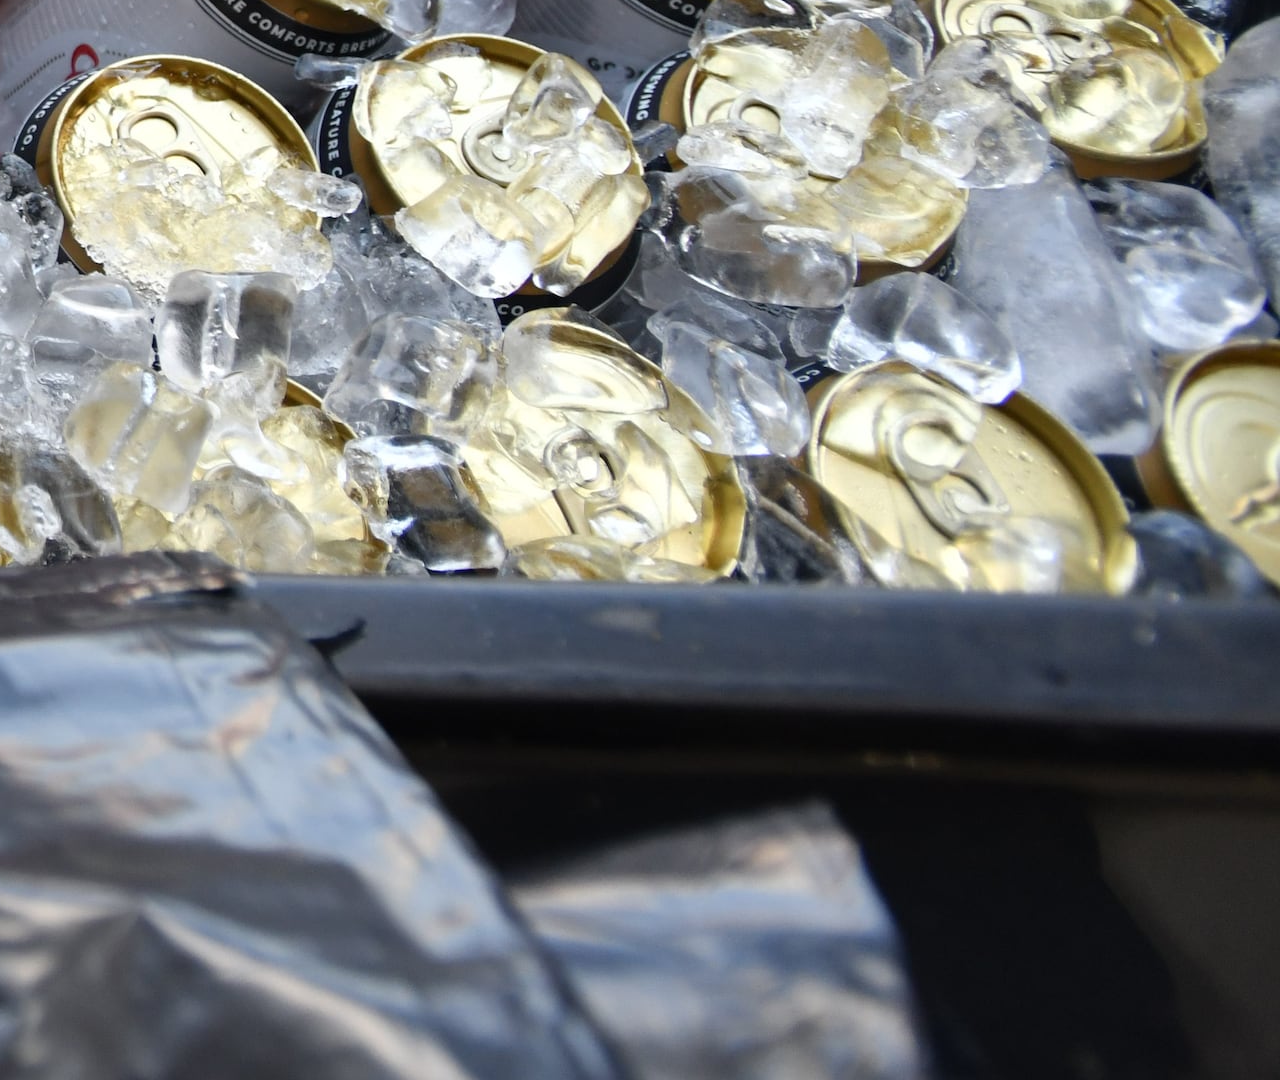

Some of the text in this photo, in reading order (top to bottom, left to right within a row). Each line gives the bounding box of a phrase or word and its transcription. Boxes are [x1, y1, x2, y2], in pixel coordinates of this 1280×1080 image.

[248, 11, 335, 55] COMFORTS
[635, 60, 677, 121] BREWING
[20, 124, 38, 152] CO.
